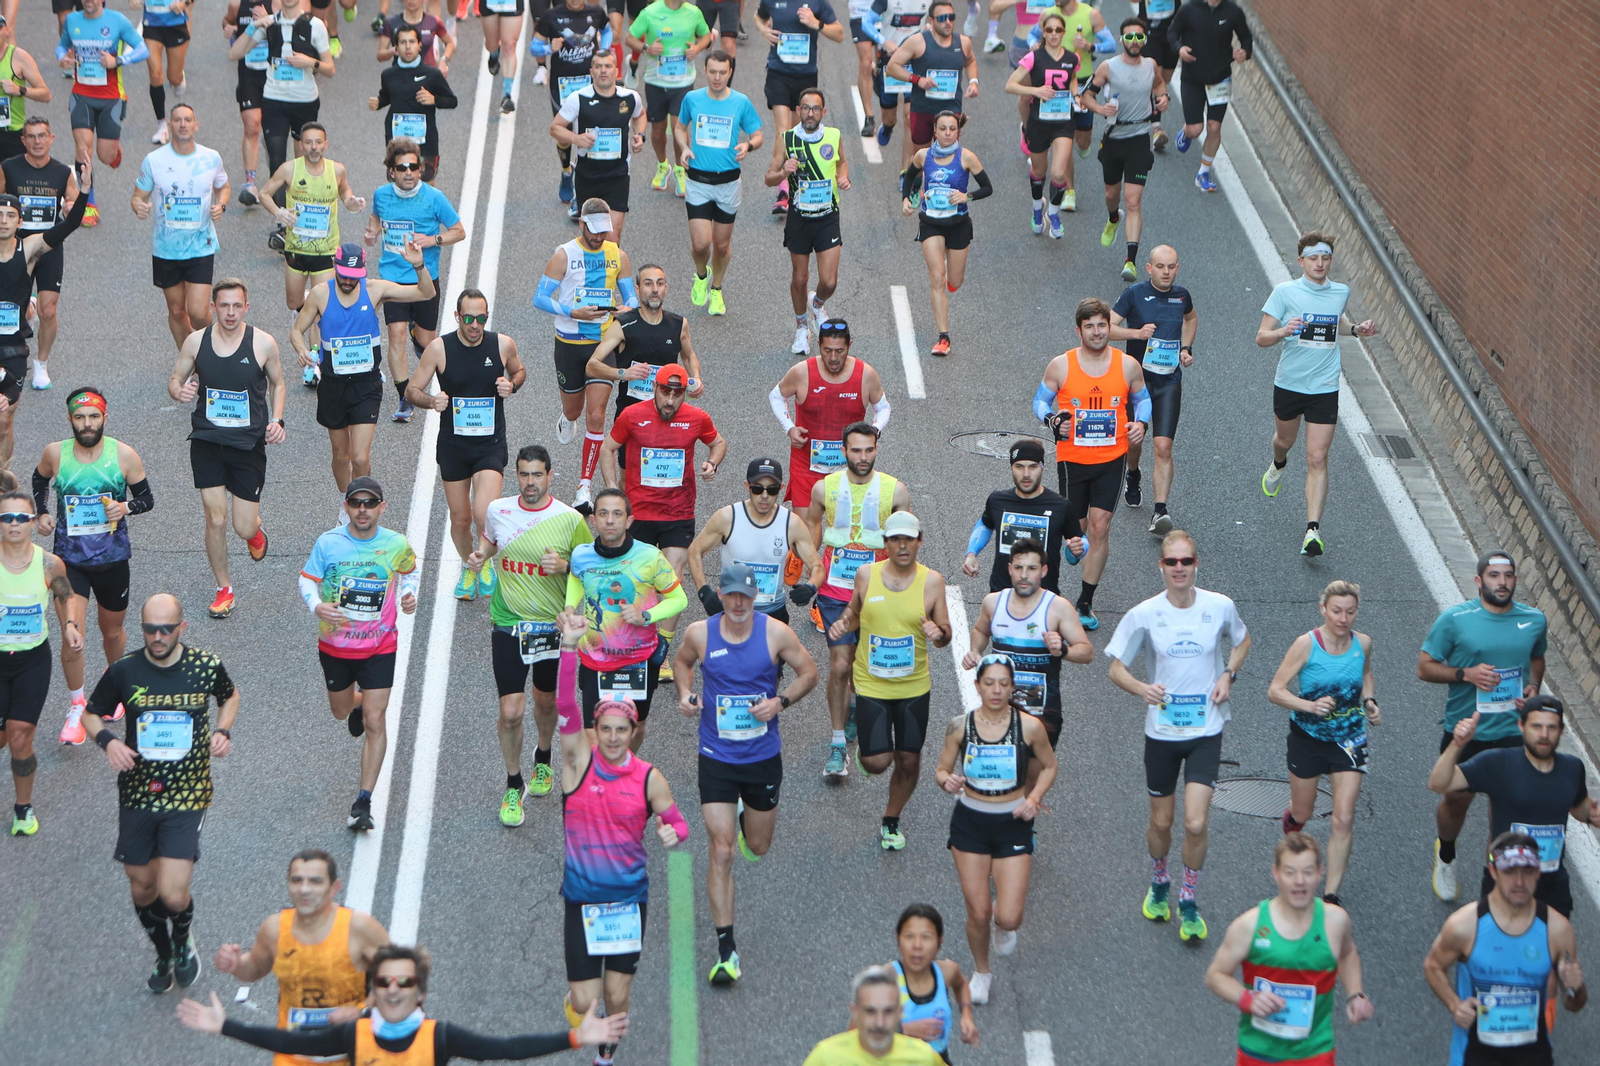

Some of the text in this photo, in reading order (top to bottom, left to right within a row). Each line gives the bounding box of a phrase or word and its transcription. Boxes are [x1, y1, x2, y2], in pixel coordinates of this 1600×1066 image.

[177, 197, 198, 205] ZURICH
[306, 205, 327, 213] ZURICH
[390, 222, 410, 230] ZURICH
[571, 259, 618, 271] CANARIAS
[345, 338, 367, 346] ZURICH
[221, 393, 245, 401] ZURICH
[221, 404, 236, 412] 6013
[467, 400, 490, 408] ZURICH
[825, 454, 840, 462] 5074
[655, 463, 670, 471] 4797
[81, 496, 104, 506] ZURIC
[1018, 516, 1043, 526] ZURICH
[846, 551, 870, 560] ZURICH
[357, 580, 384, 590] ZURICH
[355, 594, 371, 603] 3003
[344, 602, 358, 611] JUAN
[10, 607, 38, 616] ZURICH
[10, 619, 28, 628] 3479
[883, 639, 909, 648] ZURICH
[710, 648, 729, 659] HOKA
[1169, 645, 1201, 655] ASTURIANA
[882, 653, 898, 661] 4885
[614, 672, 630, 681] 3028
[1014, 674, 1040, 684] ZURICH
[139, 692, 206, 708] BEFASTER
[1174, 695, 1202, 705] ZURICH
[155, 713, 186, 723] ZURICH
[735, 723, 752, 731] MARK
[156, 729, 174, 738] 3491
[155, 740, 176, 748] MAREK
[980, 748, 1008, 757] ZURICH
[1530, 828, 1558, 838] ZURICH
[602, 904, 633, 916] ZURICH
